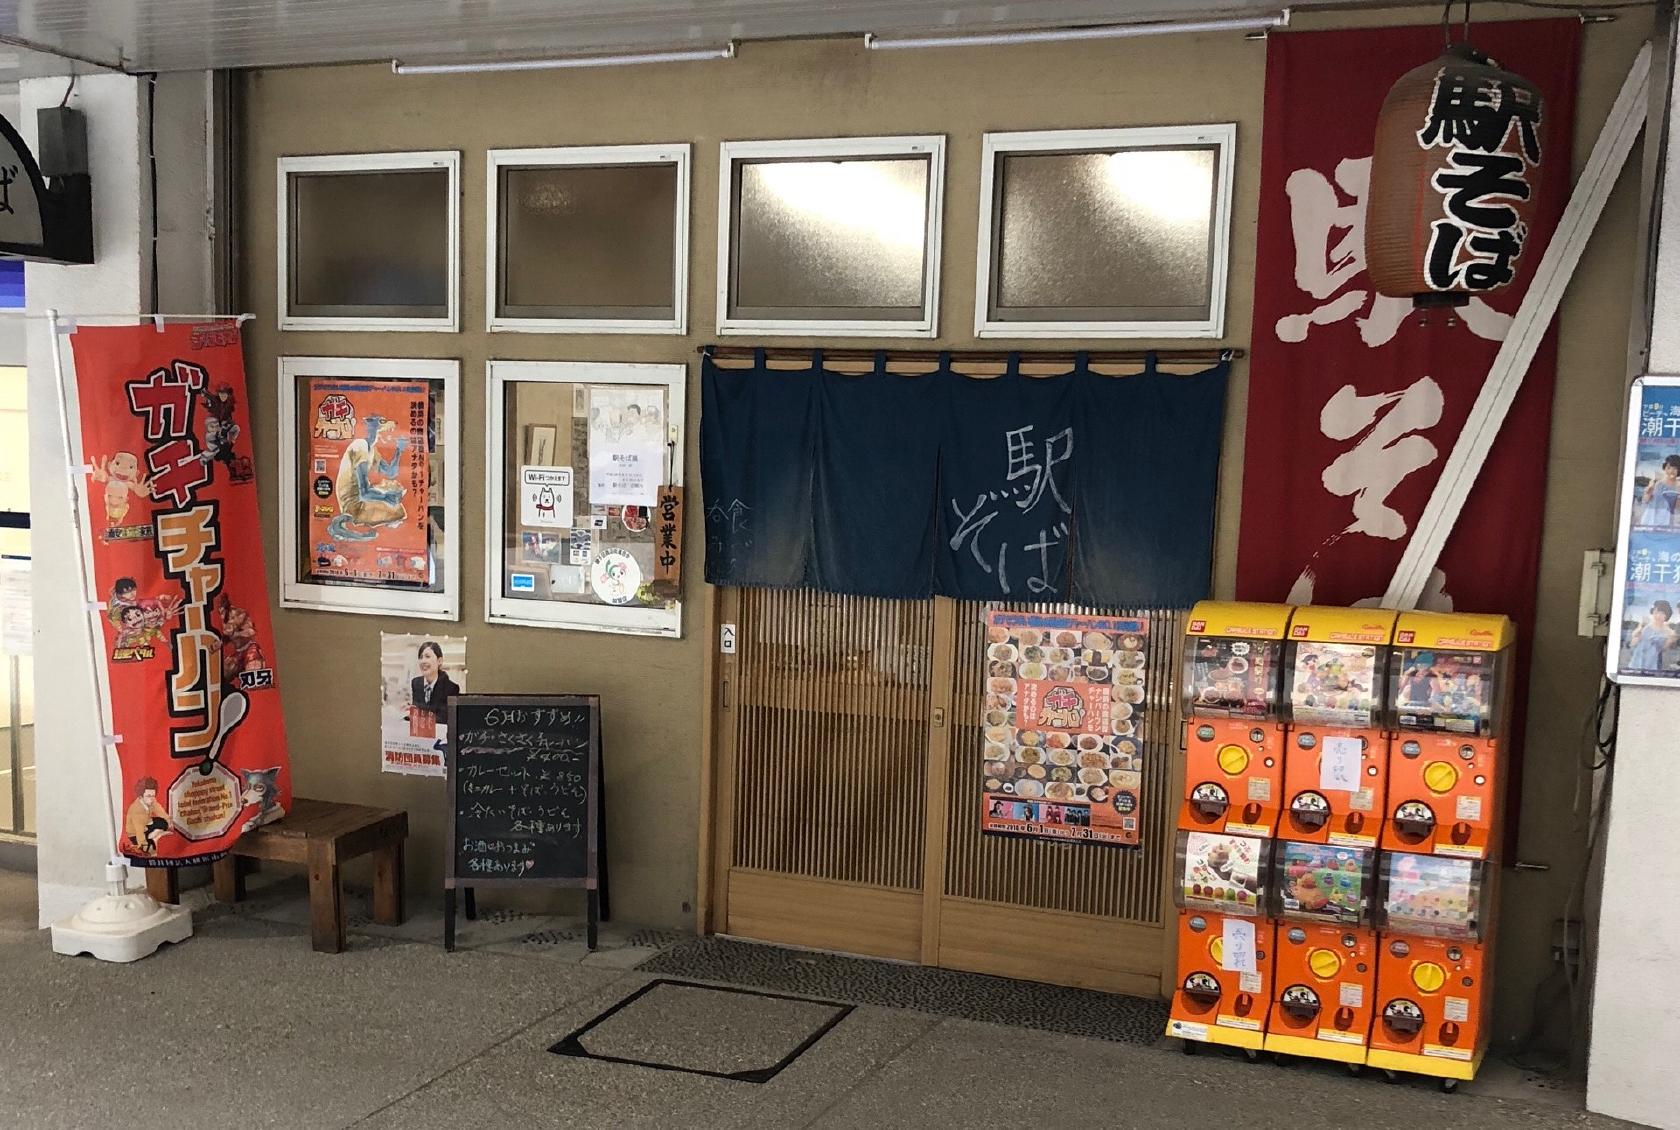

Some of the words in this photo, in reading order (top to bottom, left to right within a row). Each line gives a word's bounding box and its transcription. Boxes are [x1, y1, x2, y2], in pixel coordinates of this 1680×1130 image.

[1416, 67, 1545, 291] 駅そば
[659, 495, 680, 574] 営業中
[724, 627, 735, 648] 入口
